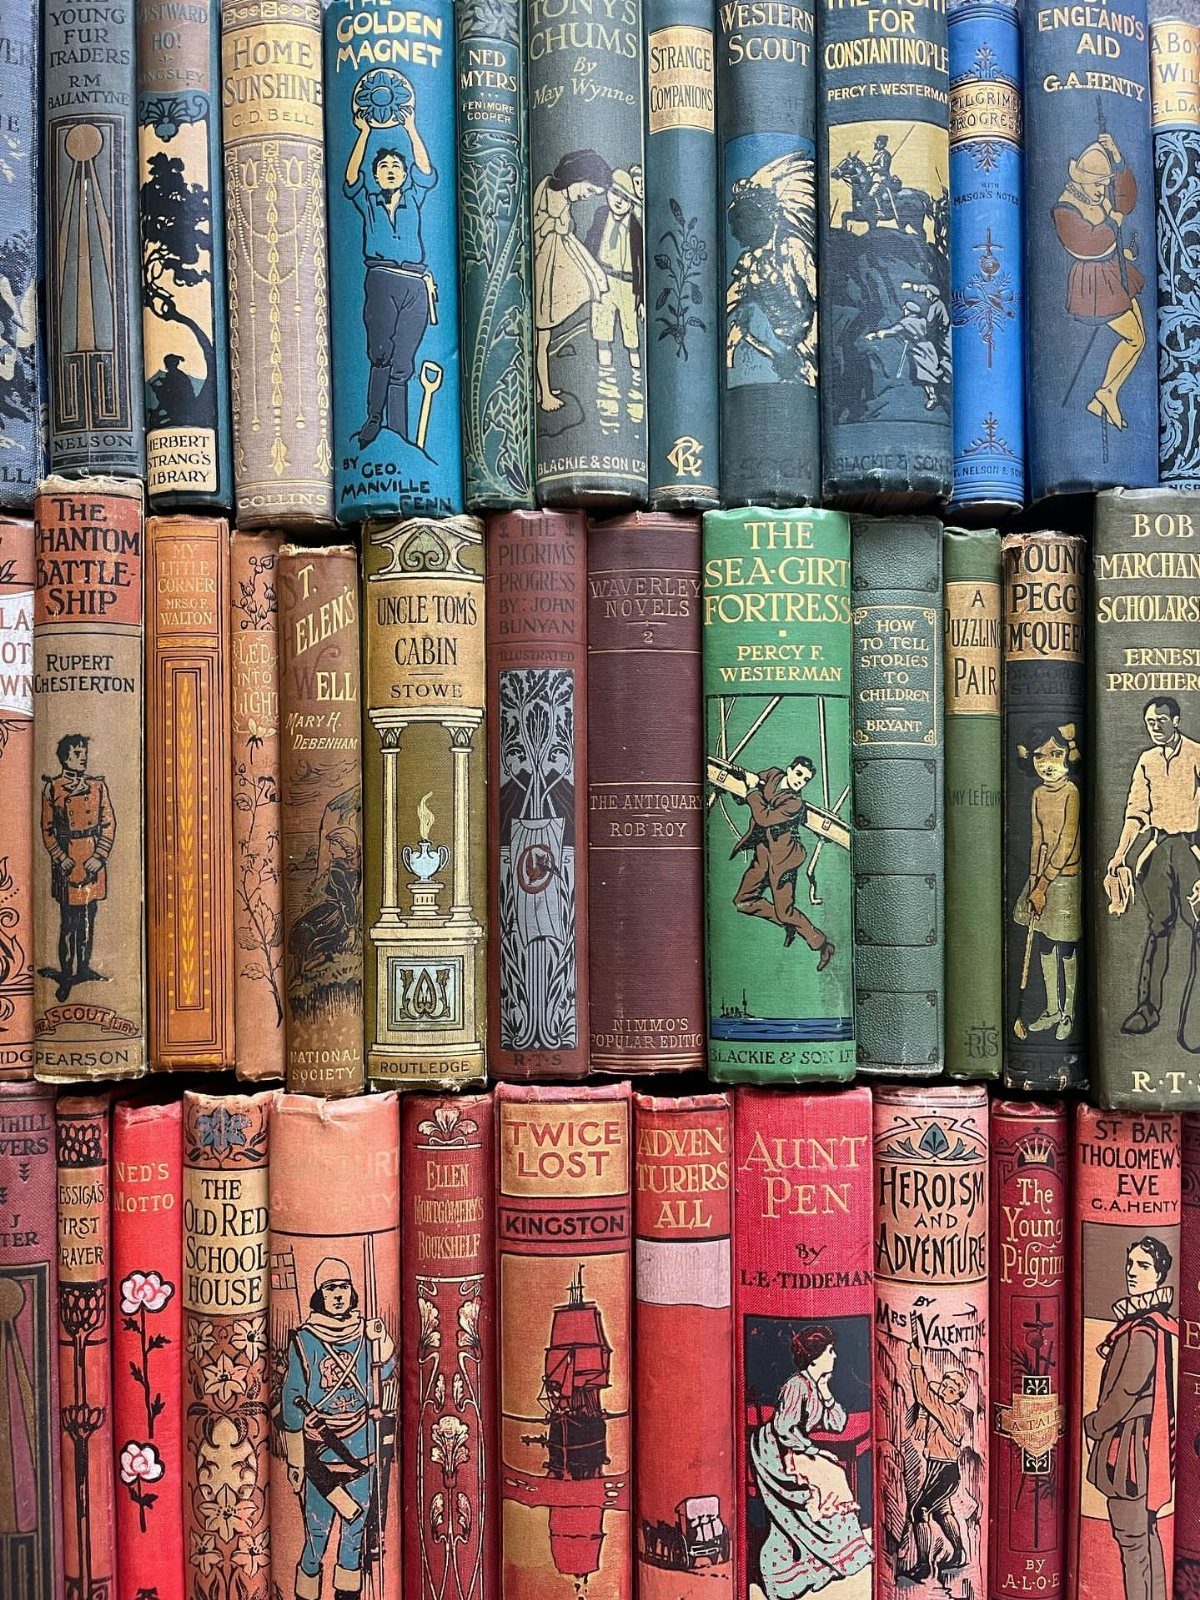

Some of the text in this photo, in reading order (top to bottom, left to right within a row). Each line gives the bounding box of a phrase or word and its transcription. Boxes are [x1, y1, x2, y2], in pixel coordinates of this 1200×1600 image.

[49, 8, 127, 27] YOUNG
[336, 10, 443, 43] GOLDEN
[719, 1, 815, 37] WESTERN
[868, 10, 915, 33] FOR
[1038, 6, 1145, 41] ENGLAND'S
[63, 28, 110, 45] FUR
[530, 21, 638, 60] CHUMS
[1076, 33, 1121, 58] AID
[49, 47, 131, 68] TRADERS
[232, 35, 314, 70] HOME
[336, 38, 443, 71] MAGNET
[468, 49, 506, 68] NED
[650, 45, 712, 74] STRANGE
[728, 34, 810, 67] SCOUT
[824, 37, 949, 74] CONSTANTINOPLE
[574, 56, 598, 77] By
[222, 72, 323, 108] SUNSHINE
[460, 69, 517, 93] MYERS
[48, 90, 130, 109] BALLANTYNE
[532, 76, 636, 111] May Wynne
[649, 83, 713, 113] COMPANIONS
[827, 84, 866, 102] PERCY
[880, 83, 948, 104] WESTERMAN
[267, 108, 314, 127] BELL
[462, 101, 515, 115] FENIMORE
[466, 112, 512, 125] COOPER
[54, 435, 134, 452] NELSON
[148, 450, 211, 469] STRANG'S
[343, 455, 402, 477] BY GEO.
[537, 455, 588, 477] BLACKIE
[590, 455, 601, 469] &
[602, 456, 629, 471] SON
[148, 470, 209, 487] LIBRARY
[963, 465, 999, 477] NELSON
[238, 491, 327, 509] COLLINS
[341, 478, 430, 502] MANVILLE
[51, 498, 107, 521] THE
[400, 494, 451, 511] FENN
[519, 519, 556, 537] THE
[744, 521, 814, 549] THE
[1132, 514, 1194, 538] BOB
[35, 521, 140, 556] PHANTOM
[173, 544, 199, 559] MY
[499, 541, 575, 567] PILGRIM'S
[161, 561, 210, 576] LITTLE
[704, 555, 850, 587] SEA-GIRT
[158, 577, 216, 593] CORNER
[499, 572, 575, 594] PROGRESS
[590, 577, 701, 599] WAVERLEY
[46, 588, 117, 616] SHIP
[377, 592, 477, 625] UNCLE TOM'S
[531, 597, 575, 614] JOHN
[604, 599, 690, 618] NOVELS
[971, 589, 985, 608] A
[160, 612, 213, 625] WALTON
[704, 593, 852, 626] FORTRESS
[499, 619, 575, 635] BUNYAN
[877, 618, 916, 632] HOW
[643, 631, 654, 643] 2
[860, 636, 929, 651] TO TELL
[394, 637, 458, 667] CABIN
[500, 651, 575, 662] ILLUSTRATED
[737, 645, 824, 661] PERCY F.
[861, 655, 928, 668] STORIES
[1125, 649, 1200, 666] ERNEST
[46, 654, 113, 672] RUPERT
[35, 674, 135, 694] CHESTERTON
[237, 668, 272, 687] INTO
[720, 666, 841, 683] WESTERMAN
[884, 671, 909, 684] TO
[954, 657, 997, 698] PAIR
[390, 684, 463, 699] STOWE
[860, 688, 930, 703] CHILDREN
[285, 711, 342, 735] MARY H.
[866, 719, 923, 734] BRYANT
[292, 734, 357, 750] DEBENHAM
[590, 794, 703, 812] THE ANTIQUARY
[610, 822, 687, 837] ROB ROY
[52, 1008, 110, 1023] SCOUT
[612, 1018, 689, 1032] NIMMO'S
[591, 1033, 704, 1049] POPULAR EDITIO
[36, 1050, 128, 1066] PEARSON
[291, 1049, 360, 1063] NATIONAL
[711, 1050, 832, 1064] BLACKIE & SON
[293, 1067, 356, 1080] SOCIETY
[380, 1059, 469, 1075] ROUTLEDGE
[506, 1120, 621, 1146] TWICE
[738, 1131, 868, 1172] AUNT
[115, 1162, 169, 1183] NED'S
[426, 1160, 469, 1190] ELLEN
[518, 1151, 609, 1178] LOST
[636, 1161, 727, 1193] TURERS
[1117, 1174, 1159, 1196] EVE
[60, 1181, 104, 1208] ESSICA'S
[201, 1179, 242, 1200] THE
[762, 1176, 851, 1218] PEN
[880, 1166, 985, 1221] HEROISM
[1016, 1178, 1053, 1214] The
[114, 1193, 174, 1213] MOTTO
[415, 1195, 484, 1224] MONTGOMERY'S
[184, 1200, 217, 1236] OLD
[220, 1202, 268, 1237] RED
[506, 1214, 624, 1235] KINGSTON
[654, 1200, 711, 1229] ALL
[914, 1213, 957, 1229] AND
[1002, 1206, 1064, 1243] Young
[418, 1231, 480, 1260] BOOKSHELF
[876, 1222, 985, 1277] ADVENTURE
[1001, 1241, 1065, 1288] Pilgrim
[189, 1276, 263, 1306] HOUSE
[913, 1296, 937, 1307] BY
[876, 1298, 985, 1346] MRS VALENTINE
[1011, 1421, 1020, 1432] A
